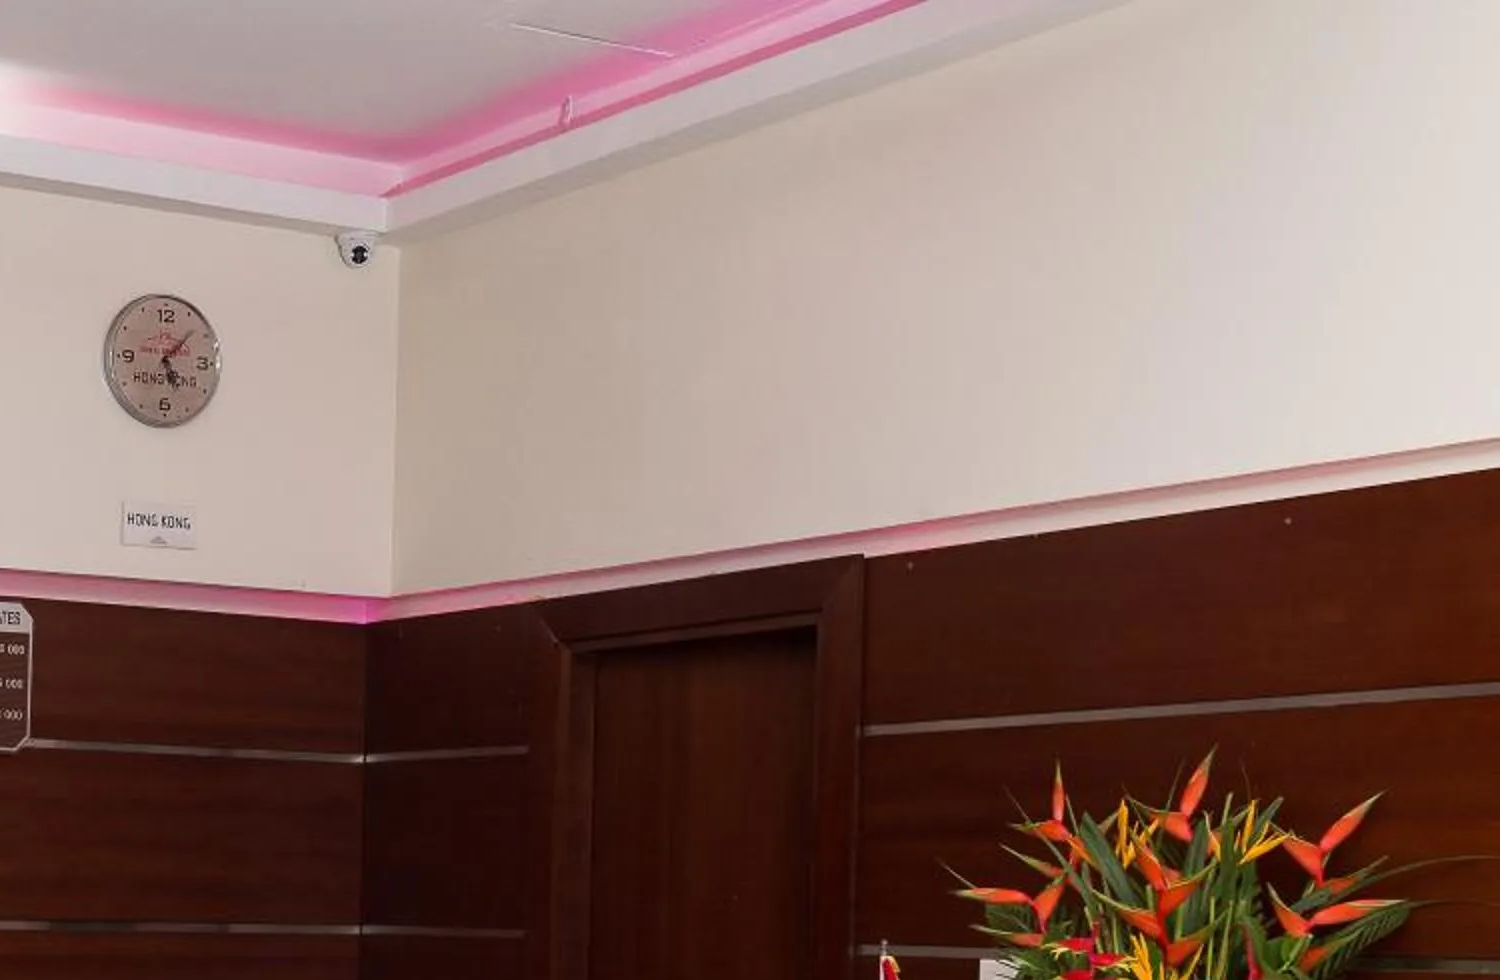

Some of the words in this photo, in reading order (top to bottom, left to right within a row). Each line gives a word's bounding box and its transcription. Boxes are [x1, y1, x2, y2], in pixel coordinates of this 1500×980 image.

[157, 309, 175, 323] 12
[121, 349, 135, 363] 9
[195, 356, 209, 371] 3
[133, 371, 164, 385] HONG
[159, 397, 171, 411] 6
[126, 511, 159, 527] HONG
[160, 514, 191, 530] KONG
